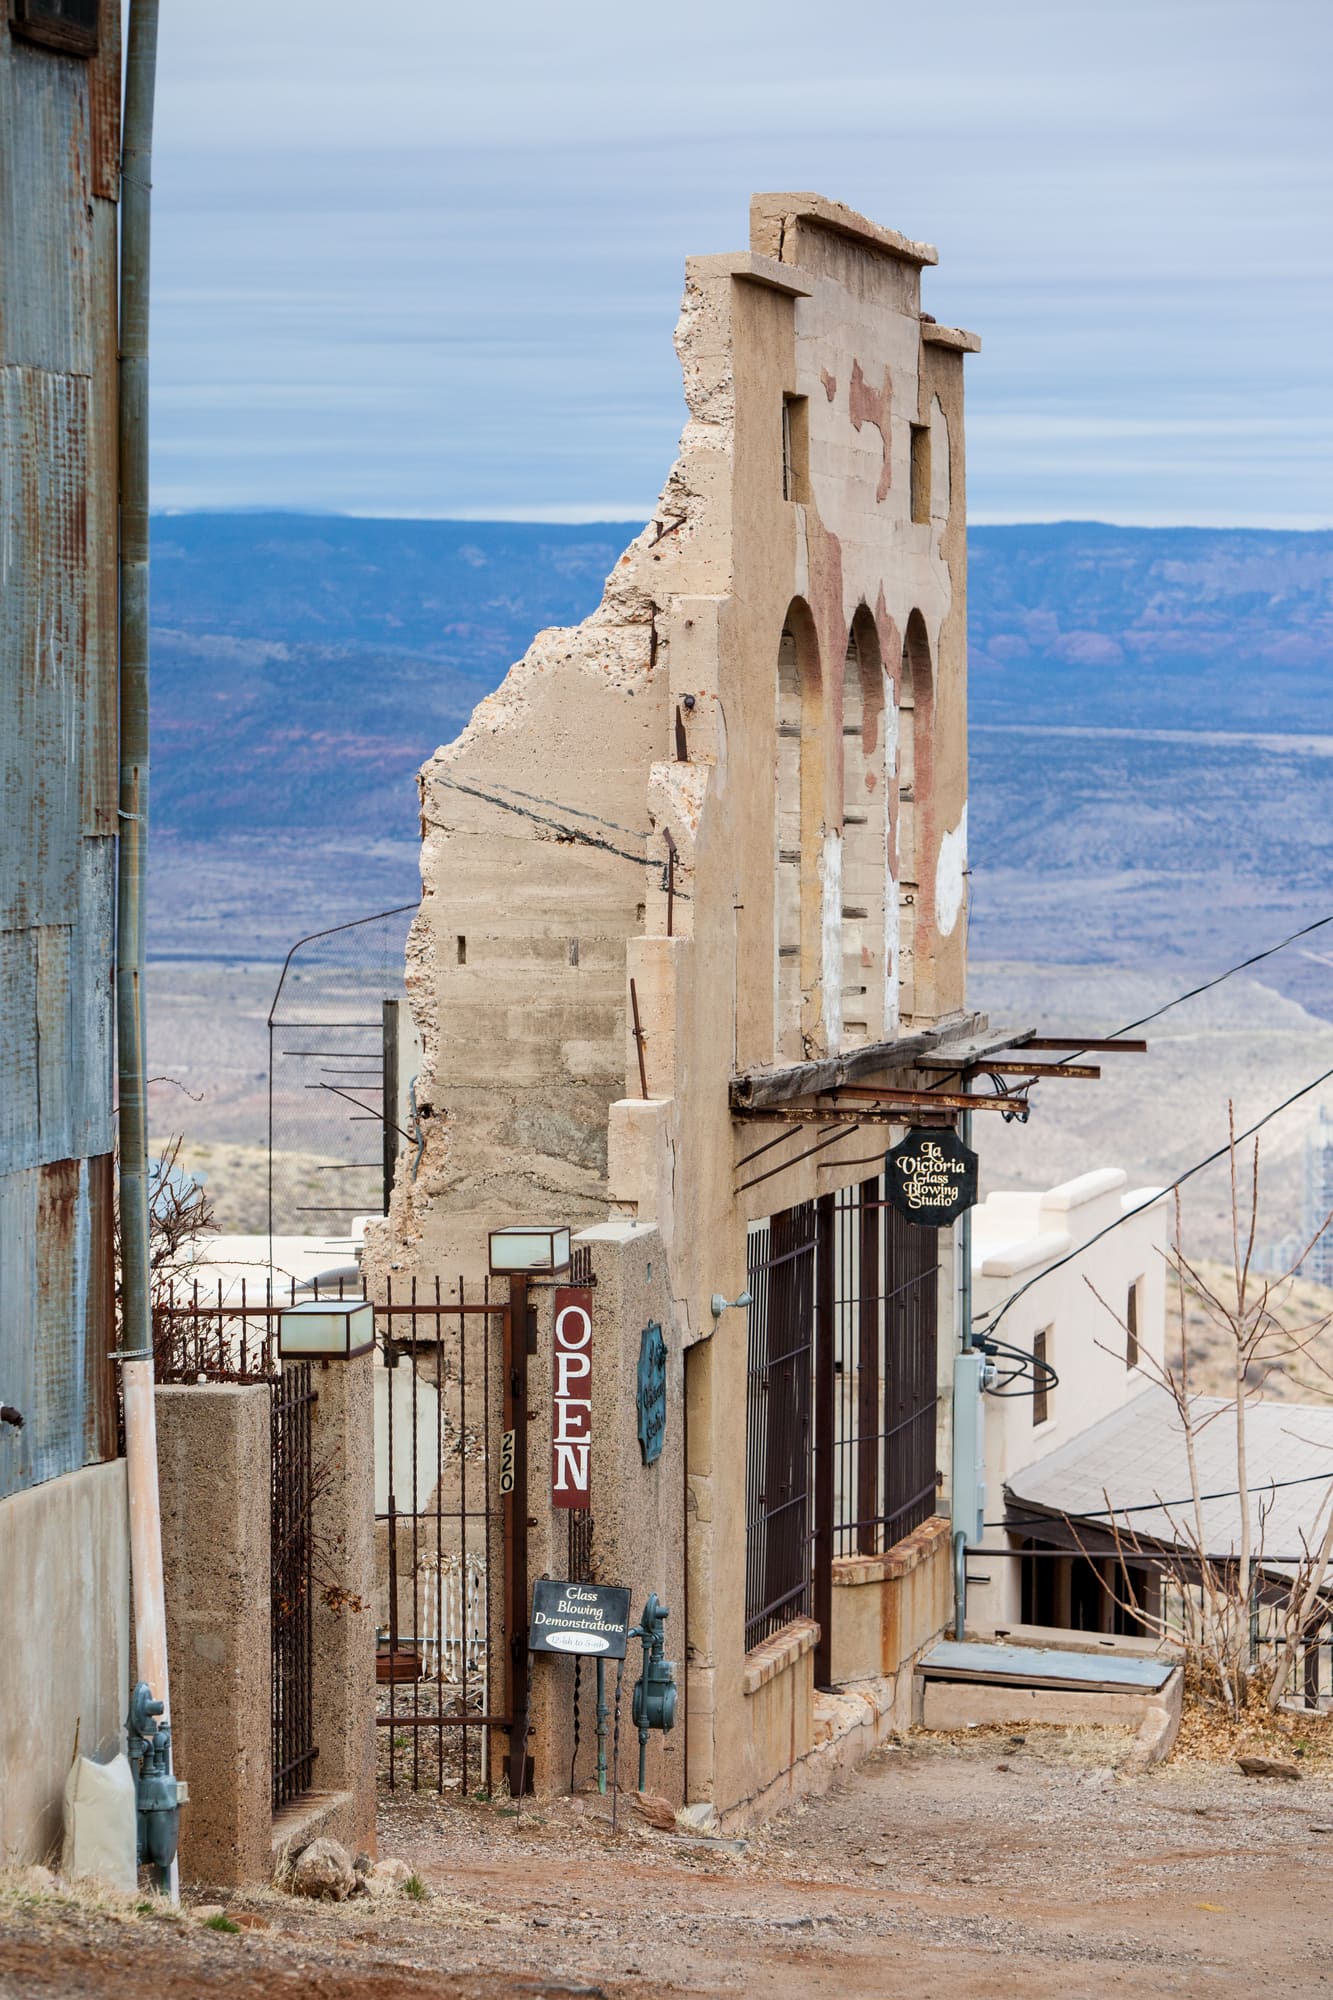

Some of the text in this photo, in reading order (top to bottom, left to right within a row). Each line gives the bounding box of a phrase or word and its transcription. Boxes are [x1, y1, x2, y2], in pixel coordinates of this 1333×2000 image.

[920, 1142, 944, 1163] La
[896, 1156, 966, 1174] Victoria
[913, 1170, 949, 1185] Glass
[903, 1181, 959, 1200] Blowing
[908, 1194, 952, 1209] Studio
[553, 1305, 592, 1491] OPEN
[501, 1433, 513, 1492] 220
[566, 1587, 598, 1601] Glass
[557, 1600, 604, 1620] Blowing
[534, 1612, 624, 1633] Demonstrations
